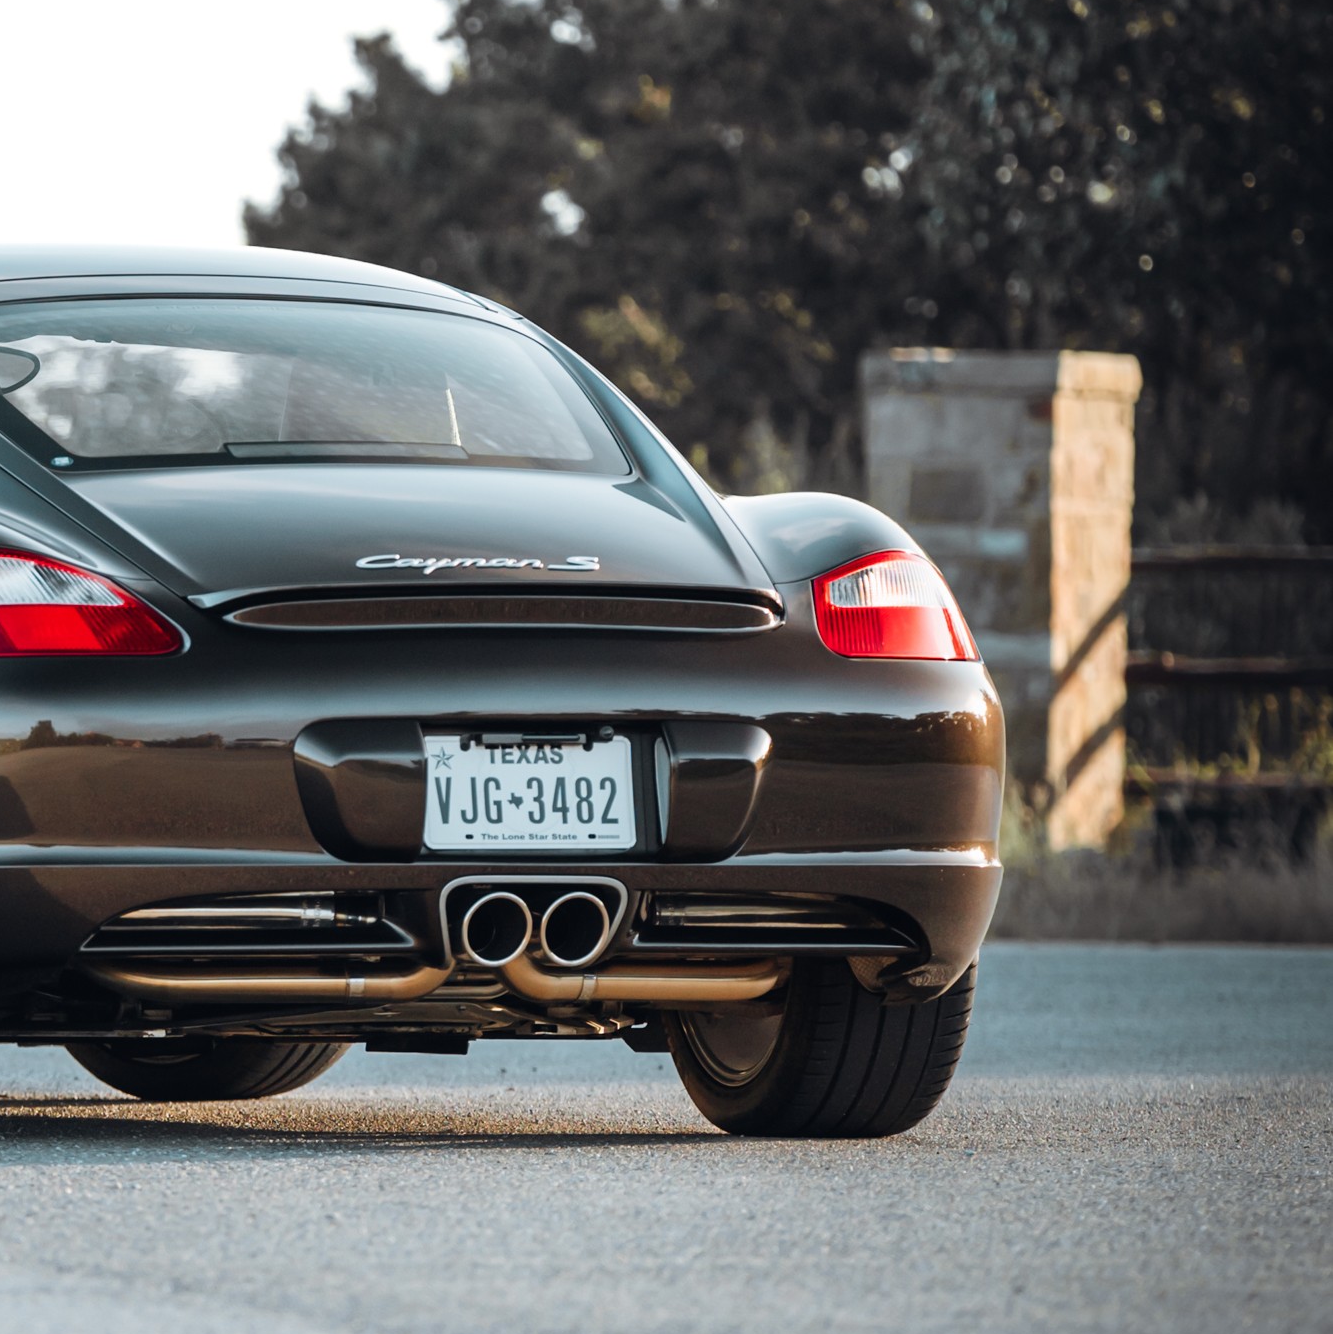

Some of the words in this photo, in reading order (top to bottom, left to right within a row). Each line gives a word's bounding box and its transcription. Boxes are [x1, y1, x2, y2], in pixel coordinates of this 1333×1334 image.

[355, 553, 544, 575] Cayman
[547, 556, 600, 571] S
[485, 745, 564, 764] TEXAS
[434, 776, 503, 824] VJG
[526, 776, 619, 824] 3482
